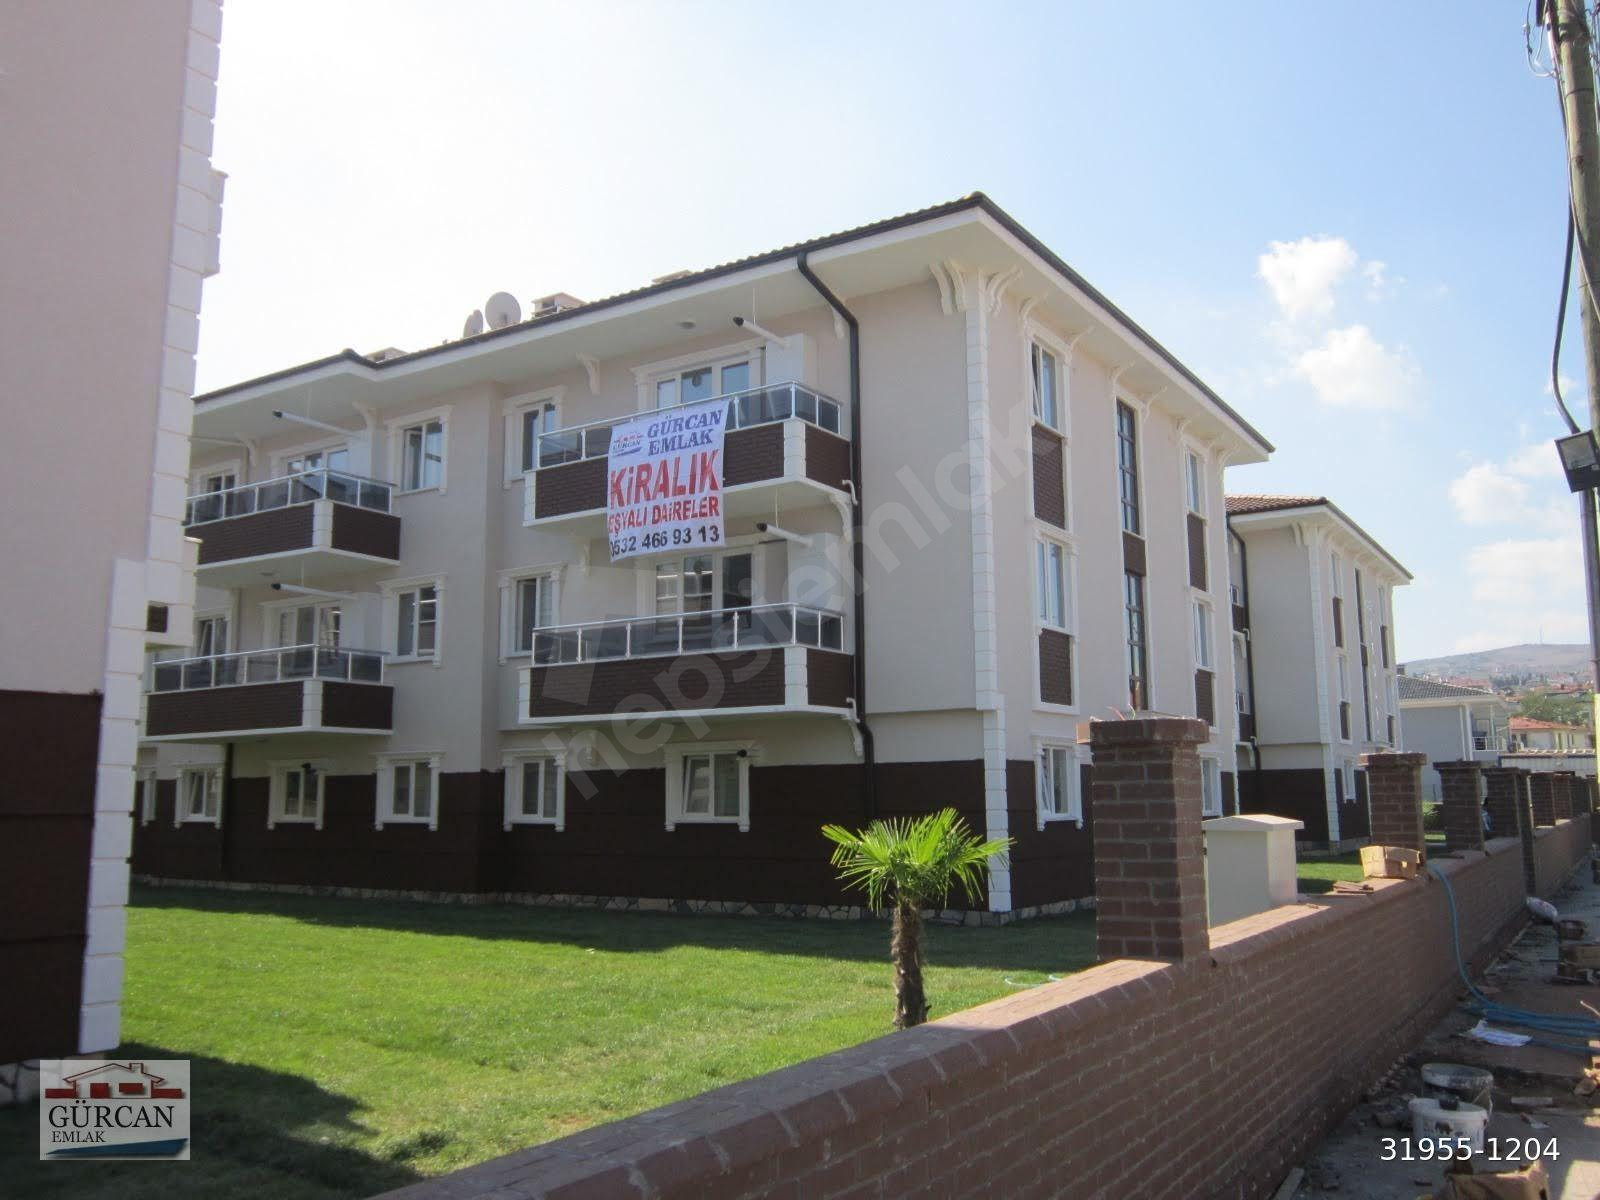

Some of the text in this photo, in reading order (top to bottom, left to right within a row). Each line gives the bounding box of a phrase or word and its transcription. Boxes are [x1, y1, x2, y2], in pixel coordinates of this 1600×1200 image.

[647, 409, 723, 439] GÜRCAN
[648, 428, 714, 457] EMLAK
[641, 530, 668, 550] 466
[672, 527, 692, 545] 93
[698, 525, 720, 543] 13
